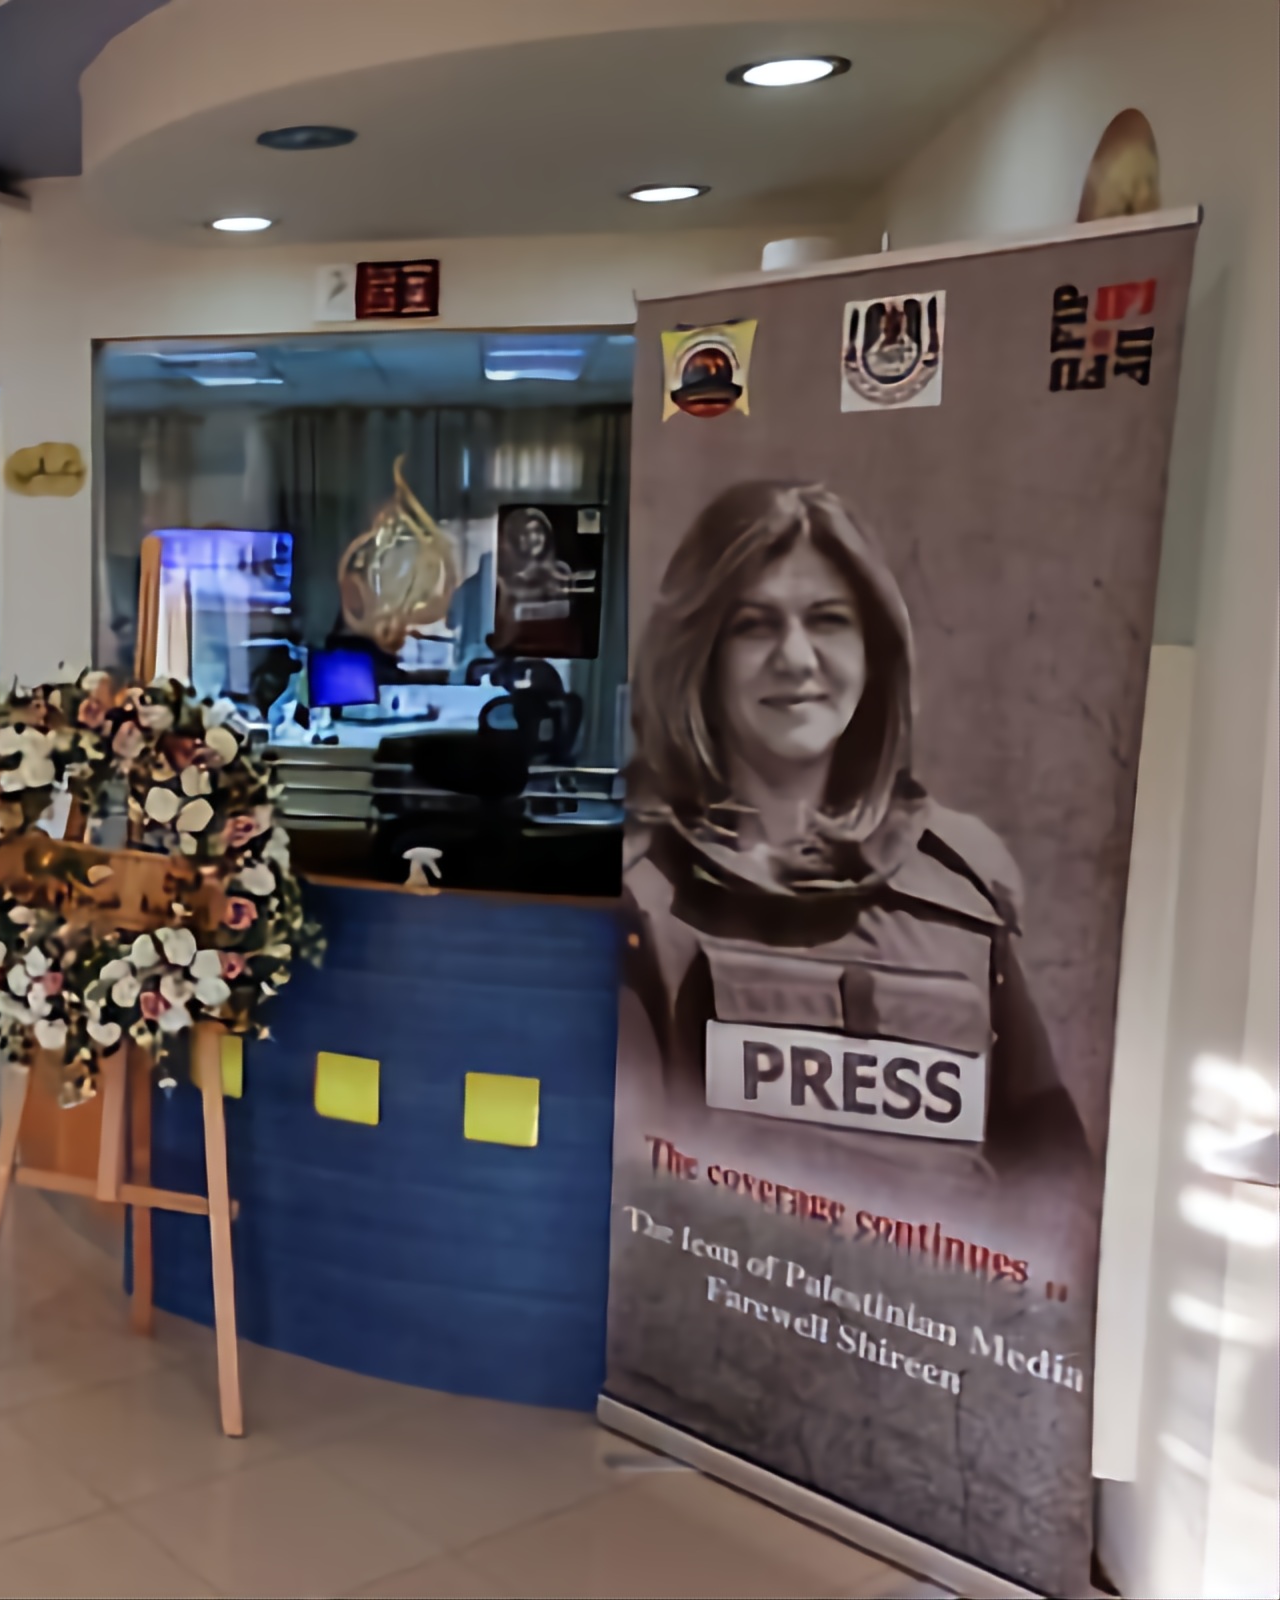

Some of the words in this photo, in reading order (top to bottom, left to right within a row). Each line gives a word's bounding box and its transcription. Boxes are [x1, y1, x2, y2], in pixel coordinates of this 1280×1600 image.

[743, 1040, 962, 1123] PRESS
[645, 1135, 699, 1181] The
[707, 1164, 846, 1226] coverage
[856, 1209, 1029, 1284] continues
[622, 1205, 674, 1244] The
[682, 1226, 740, 1270] Icon
[746, 1254, 779, 1281] of
[785, 1260, 957, 1347] Palestinian
[970, 1325, 1084, 1393] Media
[706, 1275, 829, 1344] Farewell
[836, 1324, 962, 1396] Shireen
